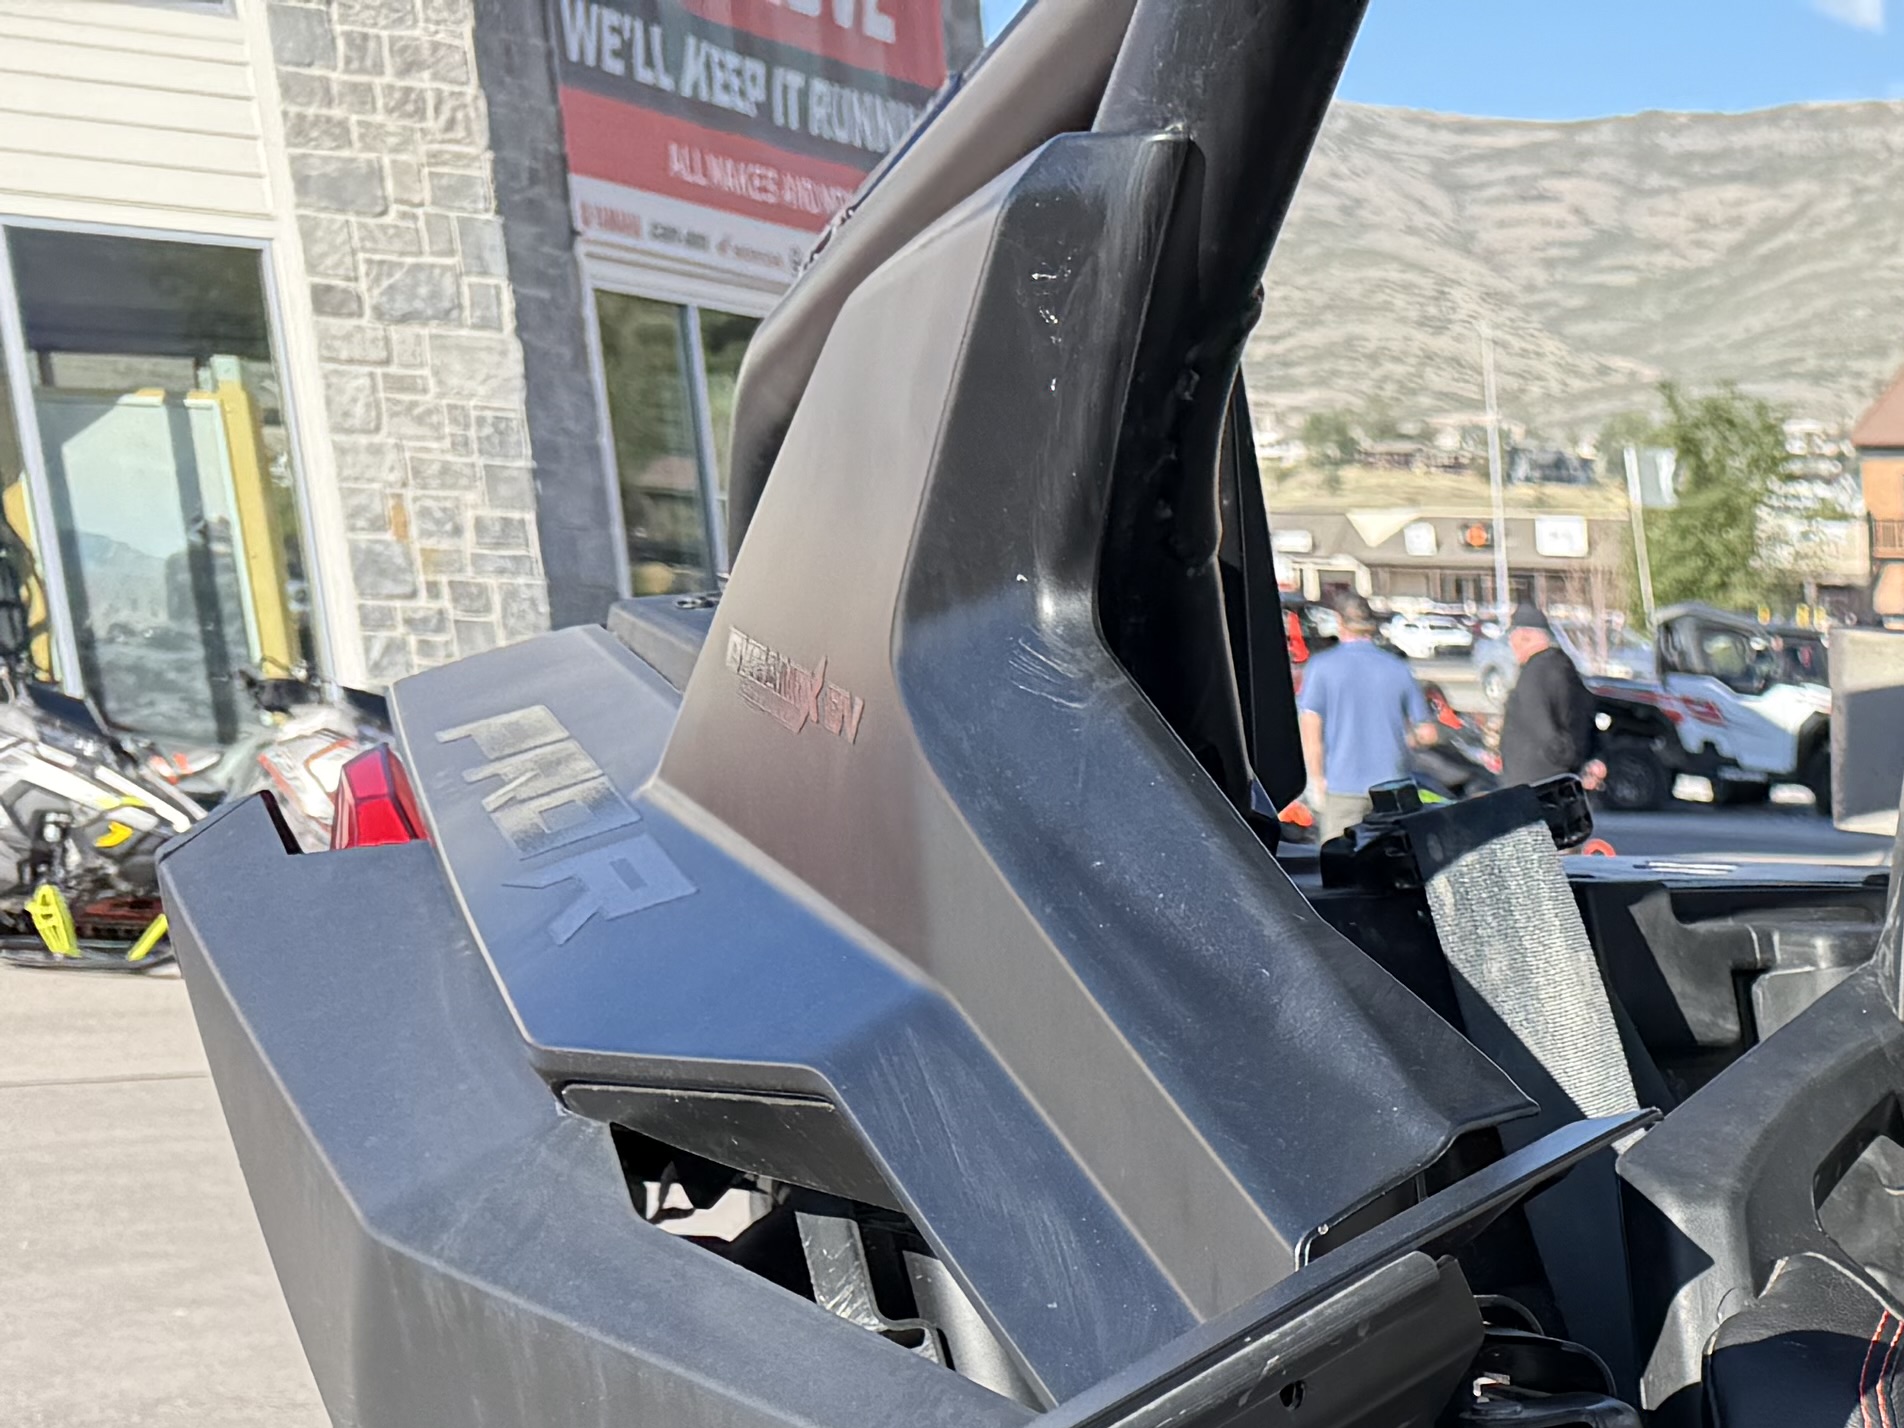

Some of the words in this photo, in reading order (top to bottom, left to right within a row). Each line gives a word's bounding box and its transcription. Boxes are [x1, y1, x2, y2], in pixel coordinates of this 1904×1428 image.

[560, 0, 675, 92] WE'LL
[680, 34, 767, 118] KEEP
[772, 65, 806, 131] IT
